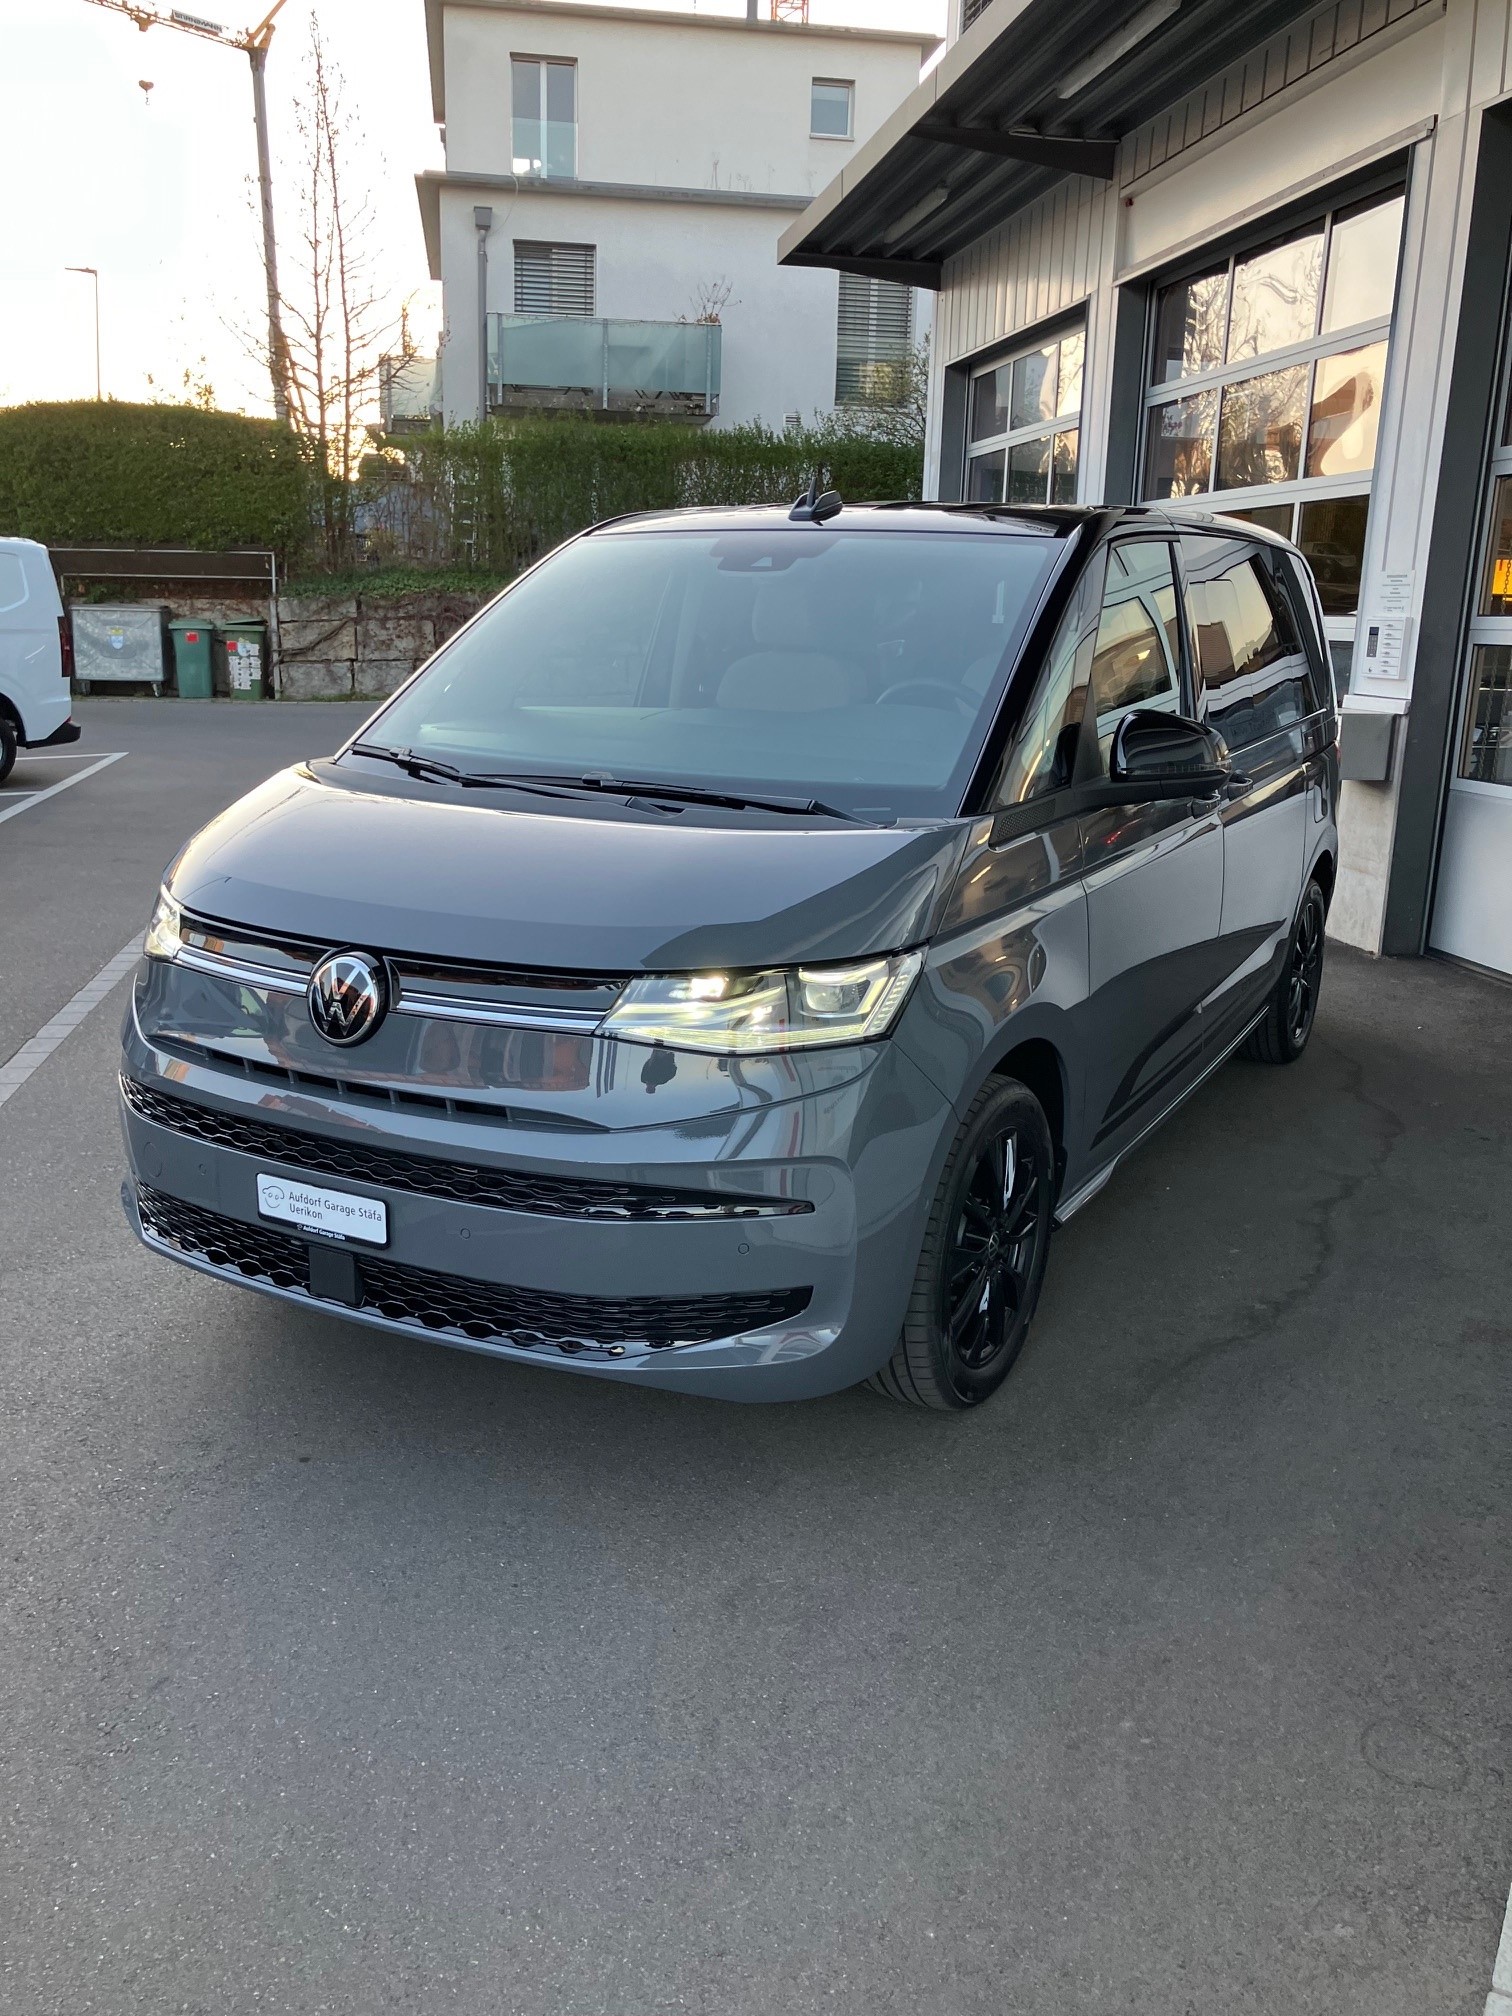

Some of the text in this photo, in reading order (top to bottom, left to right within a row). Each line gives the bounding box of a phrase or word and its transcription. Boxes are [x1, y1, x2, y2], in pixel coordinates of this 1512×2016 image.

[289, 1192, 382, 1221] Aufdorf Garage Stäfa
[289, 1203, 323, 1220] Uerikon
